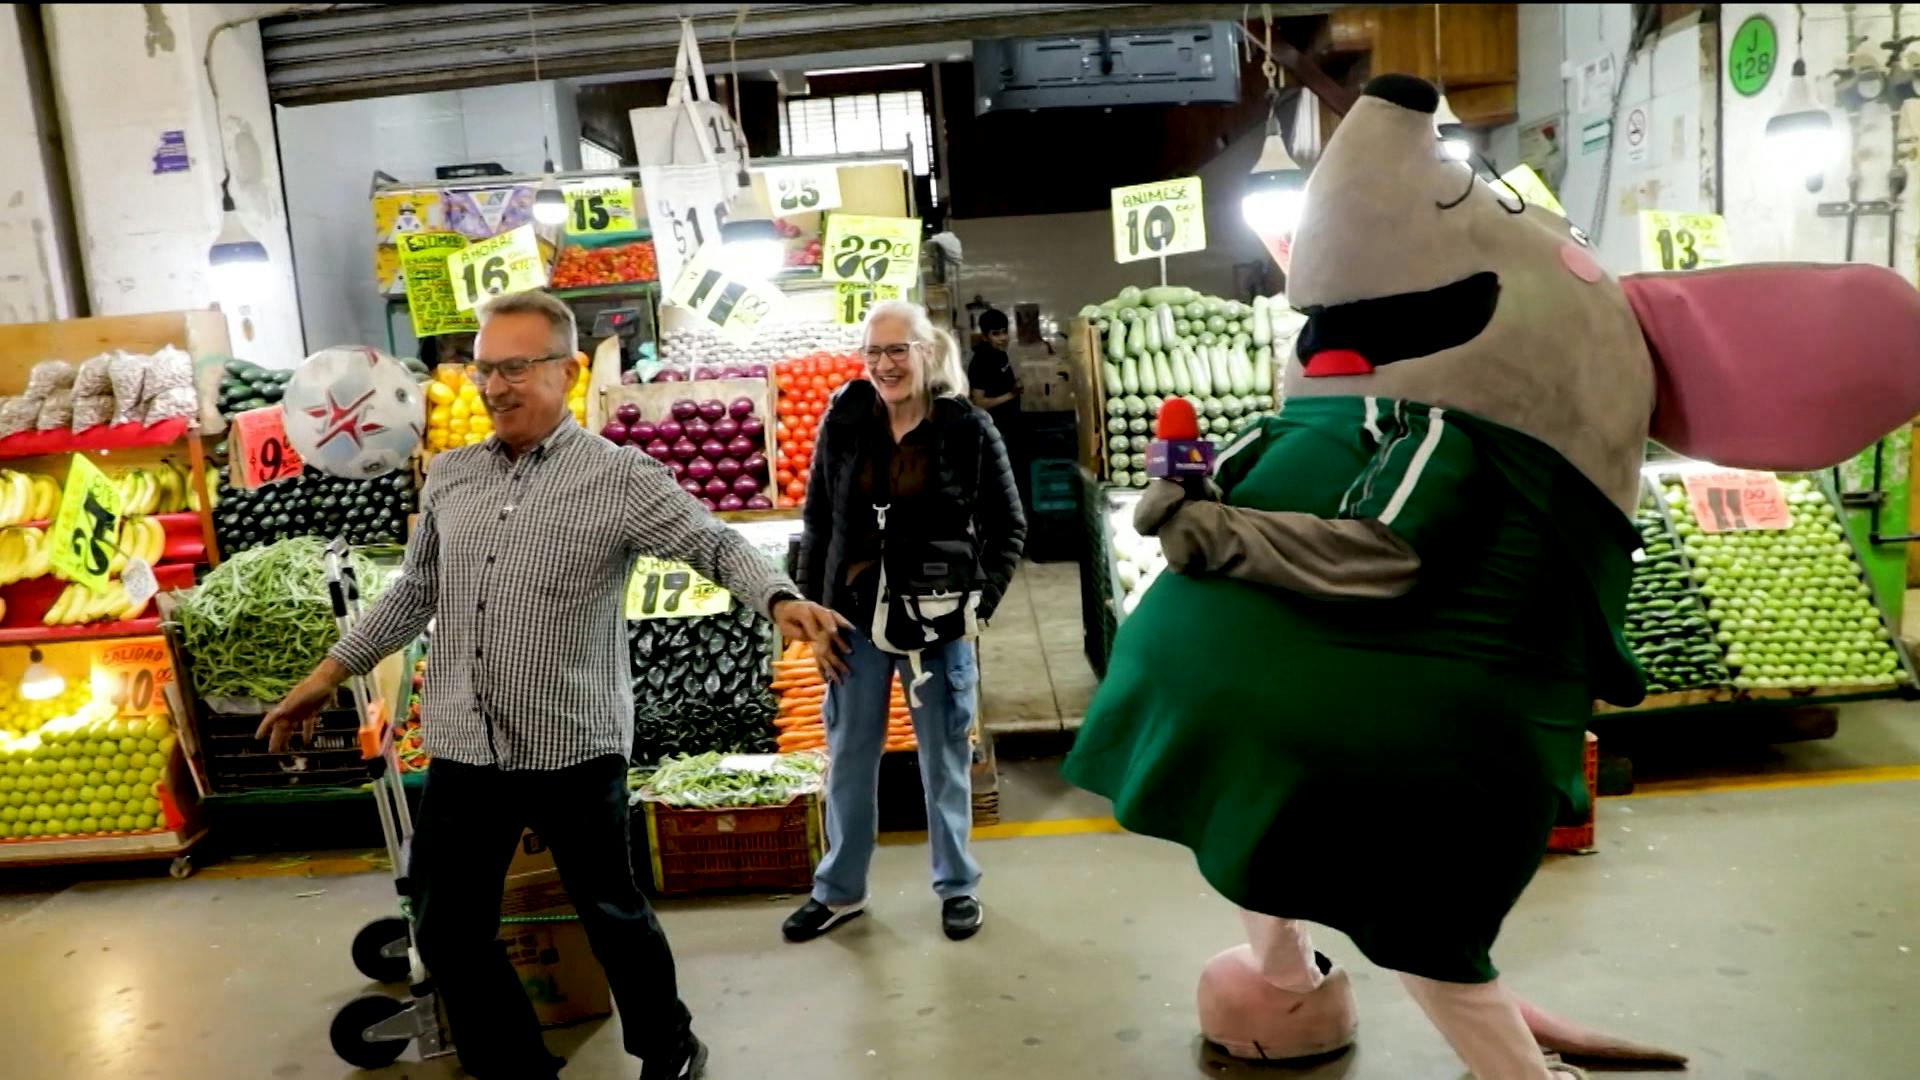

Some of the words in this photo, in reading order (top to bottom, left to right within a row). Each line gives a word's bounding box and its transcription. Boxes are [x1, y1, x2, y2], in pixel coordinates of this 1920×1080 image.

[1746, 27, 1759, 54] J
[1735, 51, 1771, 82] 128
[574, 195, 610, 231] 15
[778, 176, 820, 210] 25
[1125, 204, 1176, 256] 10
[1656, 228, 1699, 270] 13
[462, 255, 510, 304] 16
[833, 235, 892, 283] 22
[641, 571, 690, 615] 17
